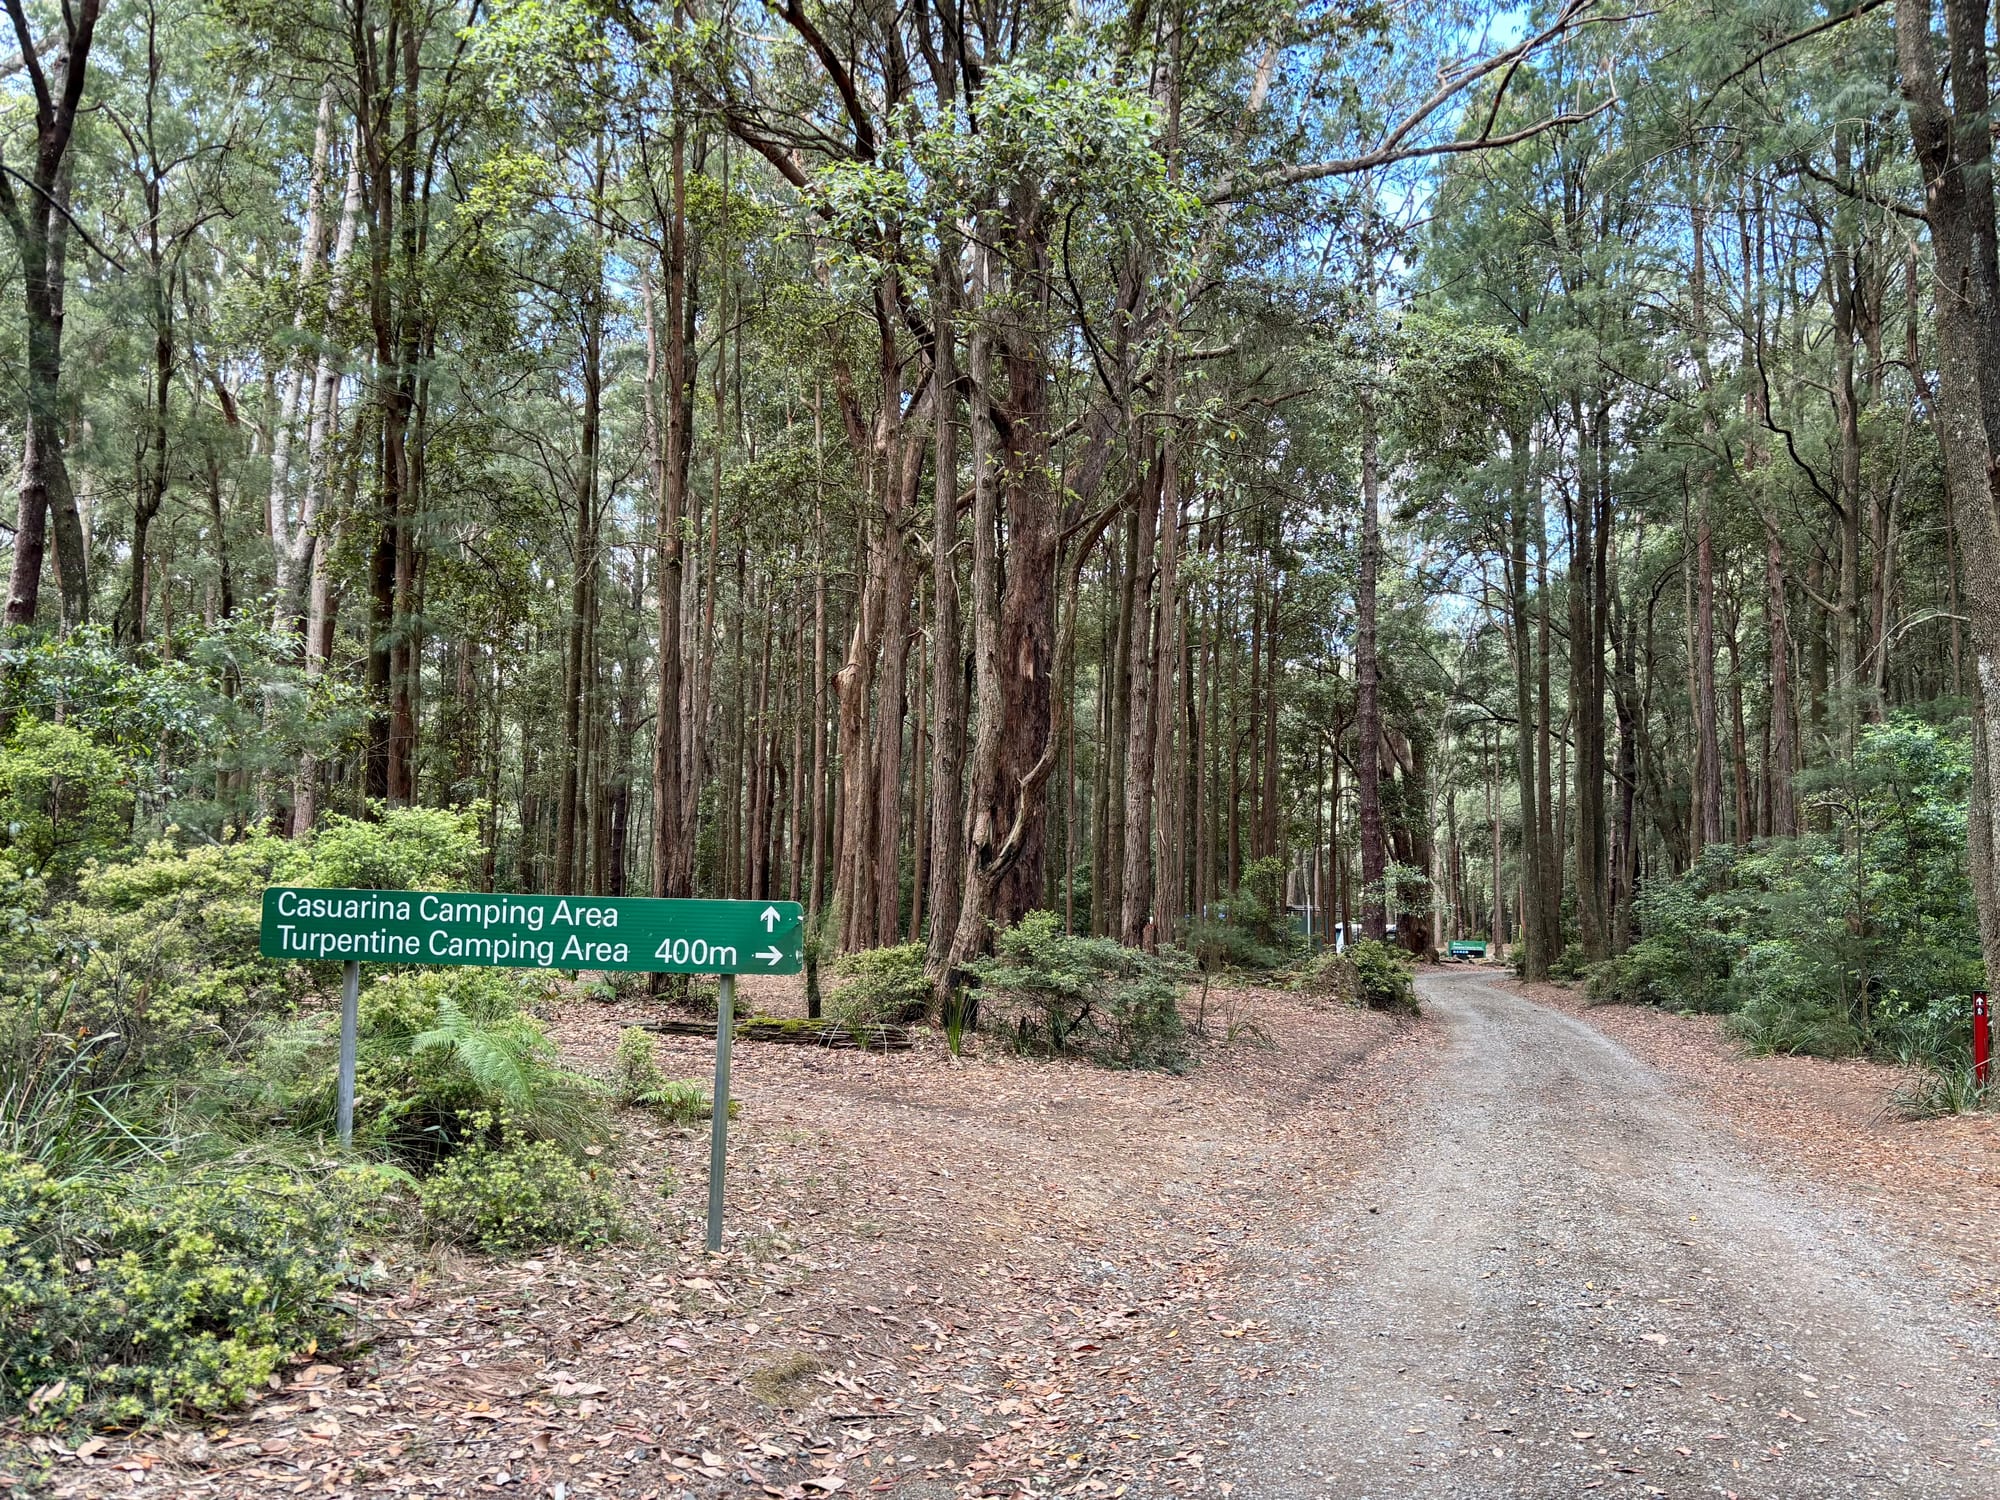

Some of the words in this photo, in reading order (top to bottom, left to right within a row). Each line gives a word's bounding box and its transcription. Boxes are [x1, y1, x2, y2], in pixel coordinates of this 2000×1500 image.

[277, 891, 411, 921] Casuarina
[419, 895, 544, 929] Camping
[550, 900, 618, 928] Area
[277, 924, 420, 958] Turpentine
[429, 929, 554, 967] Camping
[560, 934, 628, 963] Area
[654, 938, 737, 966] 400m
